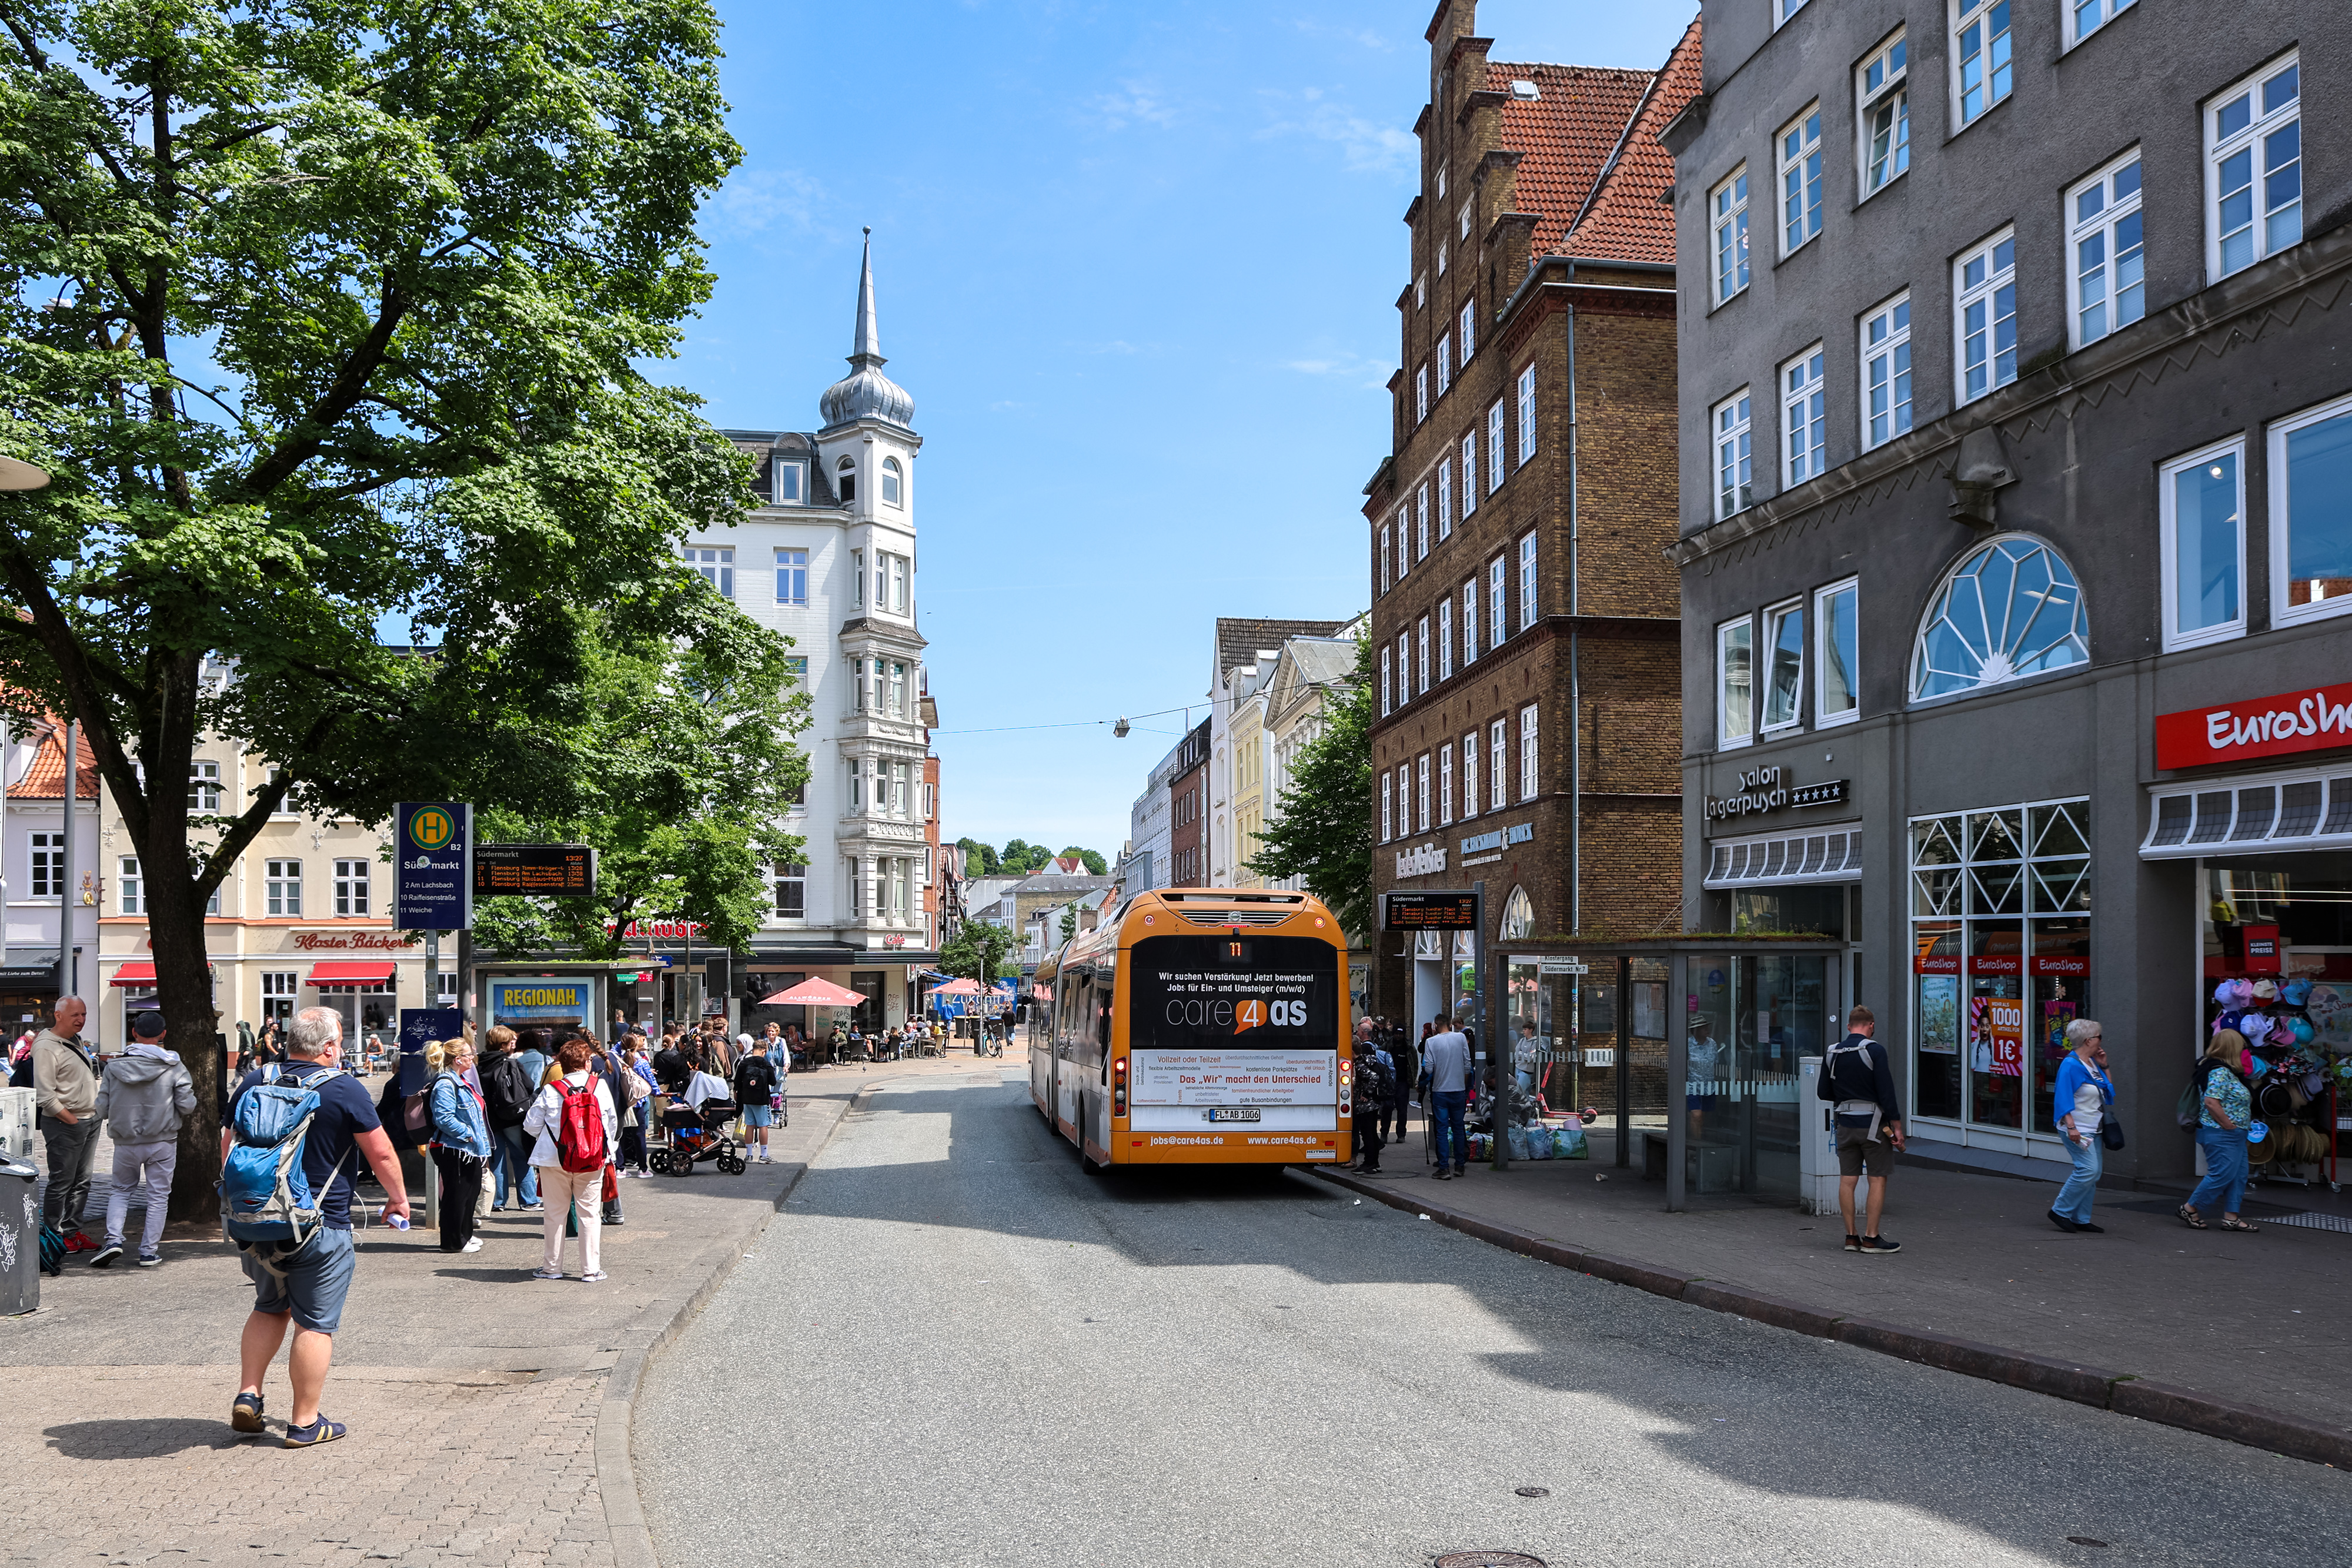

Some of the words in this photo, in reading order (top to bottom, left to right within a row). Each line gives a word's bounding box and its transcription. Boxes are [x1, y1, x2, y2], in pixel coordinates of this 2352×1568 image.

[1739, 765, 1780, 793] Salon
[1705, 788, 1786, 820] Lagerpusch
[423, 816, 440, 840] H
[1501, 826, 1509, 851] &
[404, 861, 459, 870] Sümarkt
[886, 934, 905, 945] Café
[1228, 942, 1241, 957] 11
[1922, 958, 1957, 971] EuroShop
[1977, 958, 2016, 971] EuroShop
[2039, 959, 2083, 973] EuroShop
[1175, 972, 1202, 981] suchen
[1204, 972, 1252, 982] Verstärkung!
[1254, 974, 1272, 982] Jetzt
[1275, 974, 1314, 982] bewerben!
[1465, 972, 1475, 981] KOFFE
[1167, 984, 1185, 992] Jobs
[1188, 984, 1198, 992] für
[1201, 984, 1215, 992] Ein-
[1235, 984, 1274, 994] Umsteiger
[1275, 984, 1305, 994] (m/w/d)
[504, 988, 580, 1007] REGIONAH.
[1992, 1007, 2020, 1026] 1000
[1998, 1039, 2016, 1061] 1€
[1180, 1075, 1195, 1084] Das
[1225, 1075, 1251, 1084] macht
[1254, 1075, 1269, 1084] den
[1272, 1075, 1321, 1084] Unterschied
[1215, 1111, 1225, 1119] FL
[1230, 1111, 1240, 1119] AB
[1241, 1110, 1259, 1119] 1006
[1150, 1136, 1224, 1146] jobs@care4as.de
[1247, 1136, 1317, 1145] www.care4as.de
